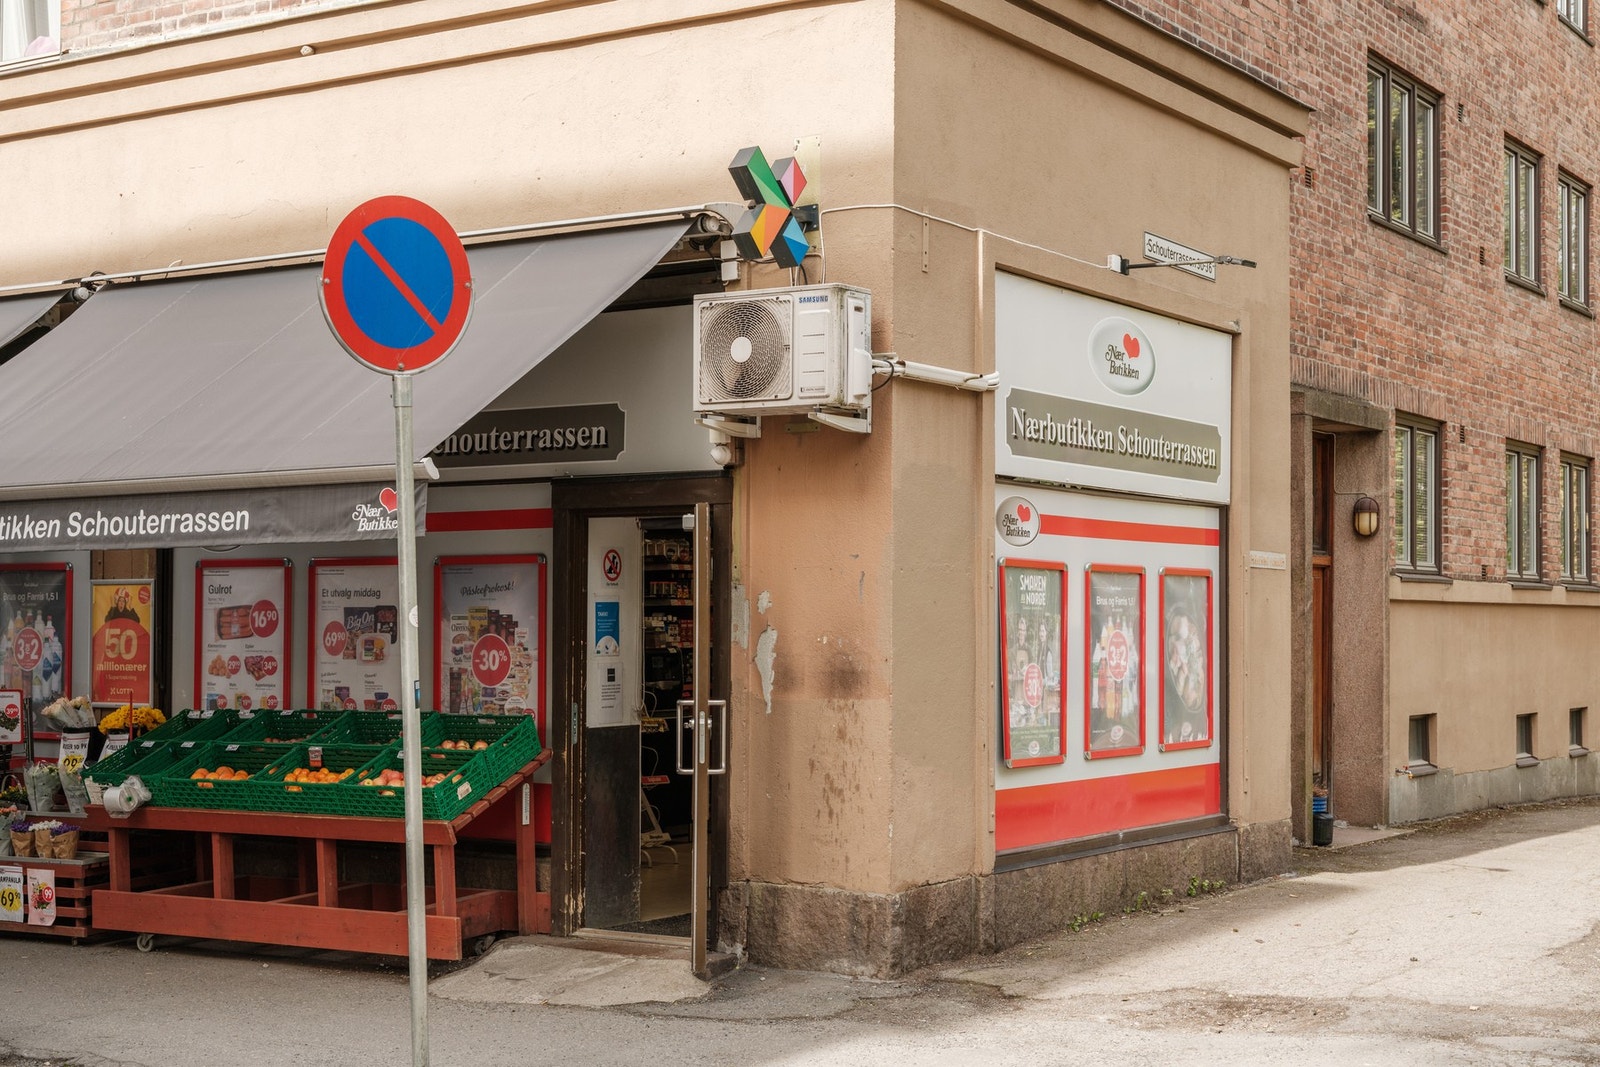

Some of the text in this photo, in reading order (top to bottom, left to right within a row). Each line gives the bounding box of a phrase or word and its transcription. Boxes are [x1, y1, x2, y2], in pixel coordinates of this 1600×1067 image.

[799, 295, 829, 304] SAMSUNG
[1105, 344, 1125, 361] Nær
[1109, 360, 1140, 380] Butikken
[1011, 406, 1217, 468] Nærbutikken Schouterrassen
[352, 504, 383, 520] Nær
[66, 509, 250, 538] Schouterrassen
[1002, 513, 1018, 528] Nær
[1005, 525, 1031, 539] Butikken
[208, 584, 232, 594] Gulrot
[460, 580, 515, 597] Påskefrokost!
[1020, 574, 1046, 591] SMAKEN
[17, 593, 26, 603] og
[321, 587, 381, 599] Et utvalg middag
[1026, 592, 1046, 606] NORGE
[105, 628, 138, 660] 50
[96, 661, 147, 671] millionærer
[475, 649, 508, 671] -30%
[116, 687, 135, 695] LOTTO
